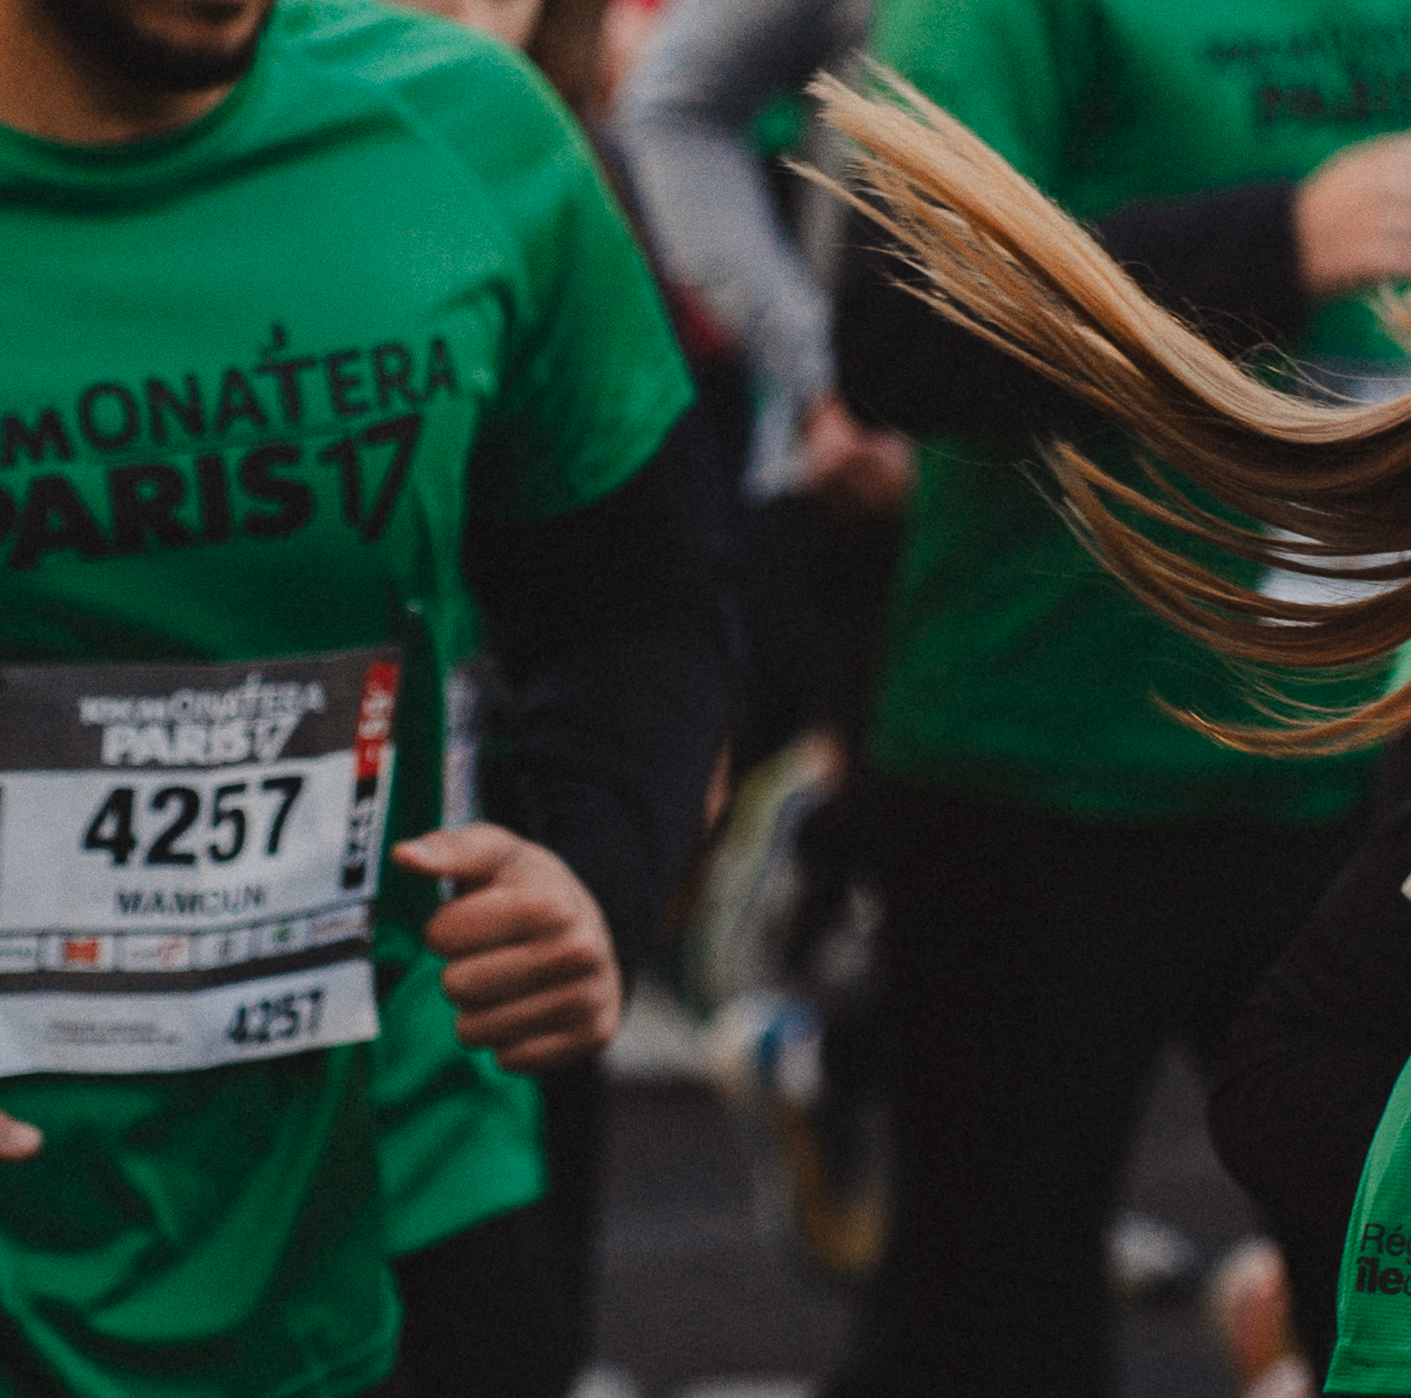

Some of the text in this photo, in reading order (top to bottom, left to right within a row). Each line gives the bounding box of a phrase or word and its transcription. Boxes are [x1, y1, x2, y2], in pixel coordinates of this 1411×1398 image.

[0, 415, 421, 571] ARIS17
[82, 777, 303, 866] 4257
[226, 988, 325, 1043] 4257
